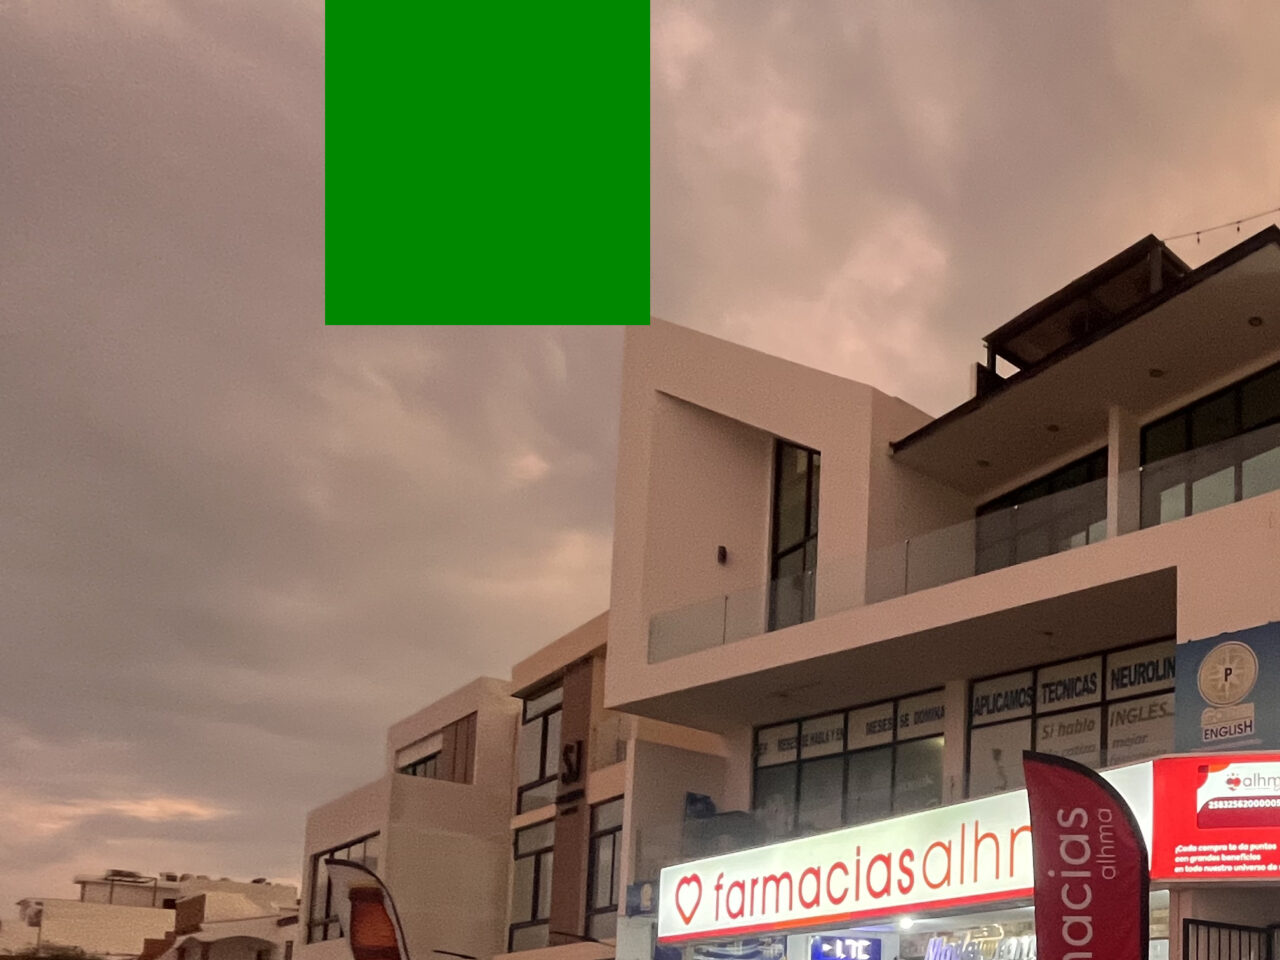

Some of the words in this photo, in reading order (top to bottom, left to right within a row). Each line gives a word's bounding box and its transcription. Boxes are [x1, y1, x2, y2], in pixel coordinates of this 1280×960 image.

[1224, 667, 1233, 682] P
[1042, 672, 1097, 704] TECNICAS
[973, 685, 1034, 717] APLICAMOS
[1058, 717, 1096, 736] hablo
[1203, 719, 1253, 740] ENGLISH
[1095, 808, 1116, 881] alhma
[1249, 843, 1277, 852] puntos
[1185, 864, 1203, 873] todo
[1203, 864, 1233, 873] nuestro
[1233, 863, 1266, 872] universo
[1189, 854, 1220, 864] grandes
[1221, 853, 1262, 861] beneficios
